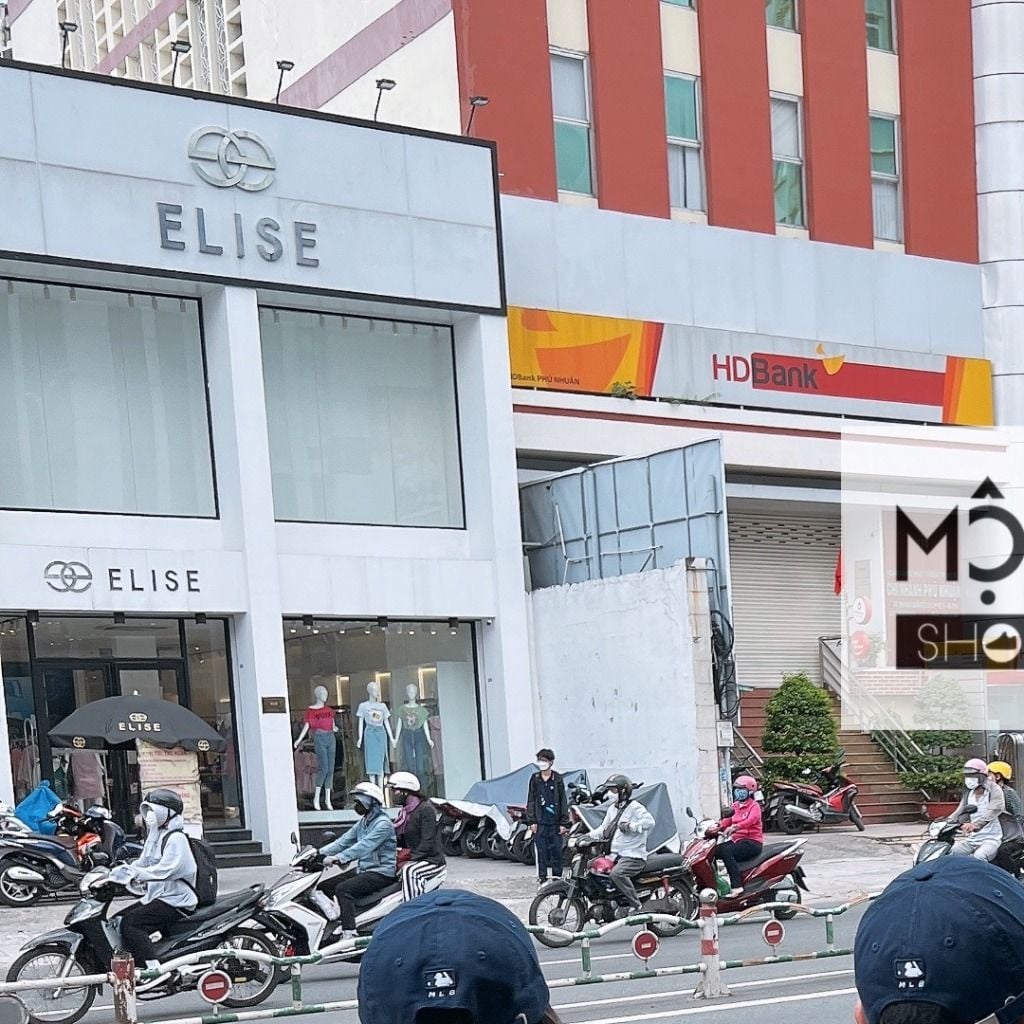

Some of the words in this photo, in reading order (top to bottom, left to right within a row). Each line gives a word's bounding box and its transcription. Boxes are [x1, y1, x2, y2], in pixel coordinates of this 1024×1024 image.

[156, 202, 320, 267] ELISE
[712, 353, 818, 389] HDBank
[109, 567, 201, 593] ELISE
[119, 722, 161, 732] ELISE
[899, 980, 925, 988] MLB
[428, 989, 455, 998] MLB
